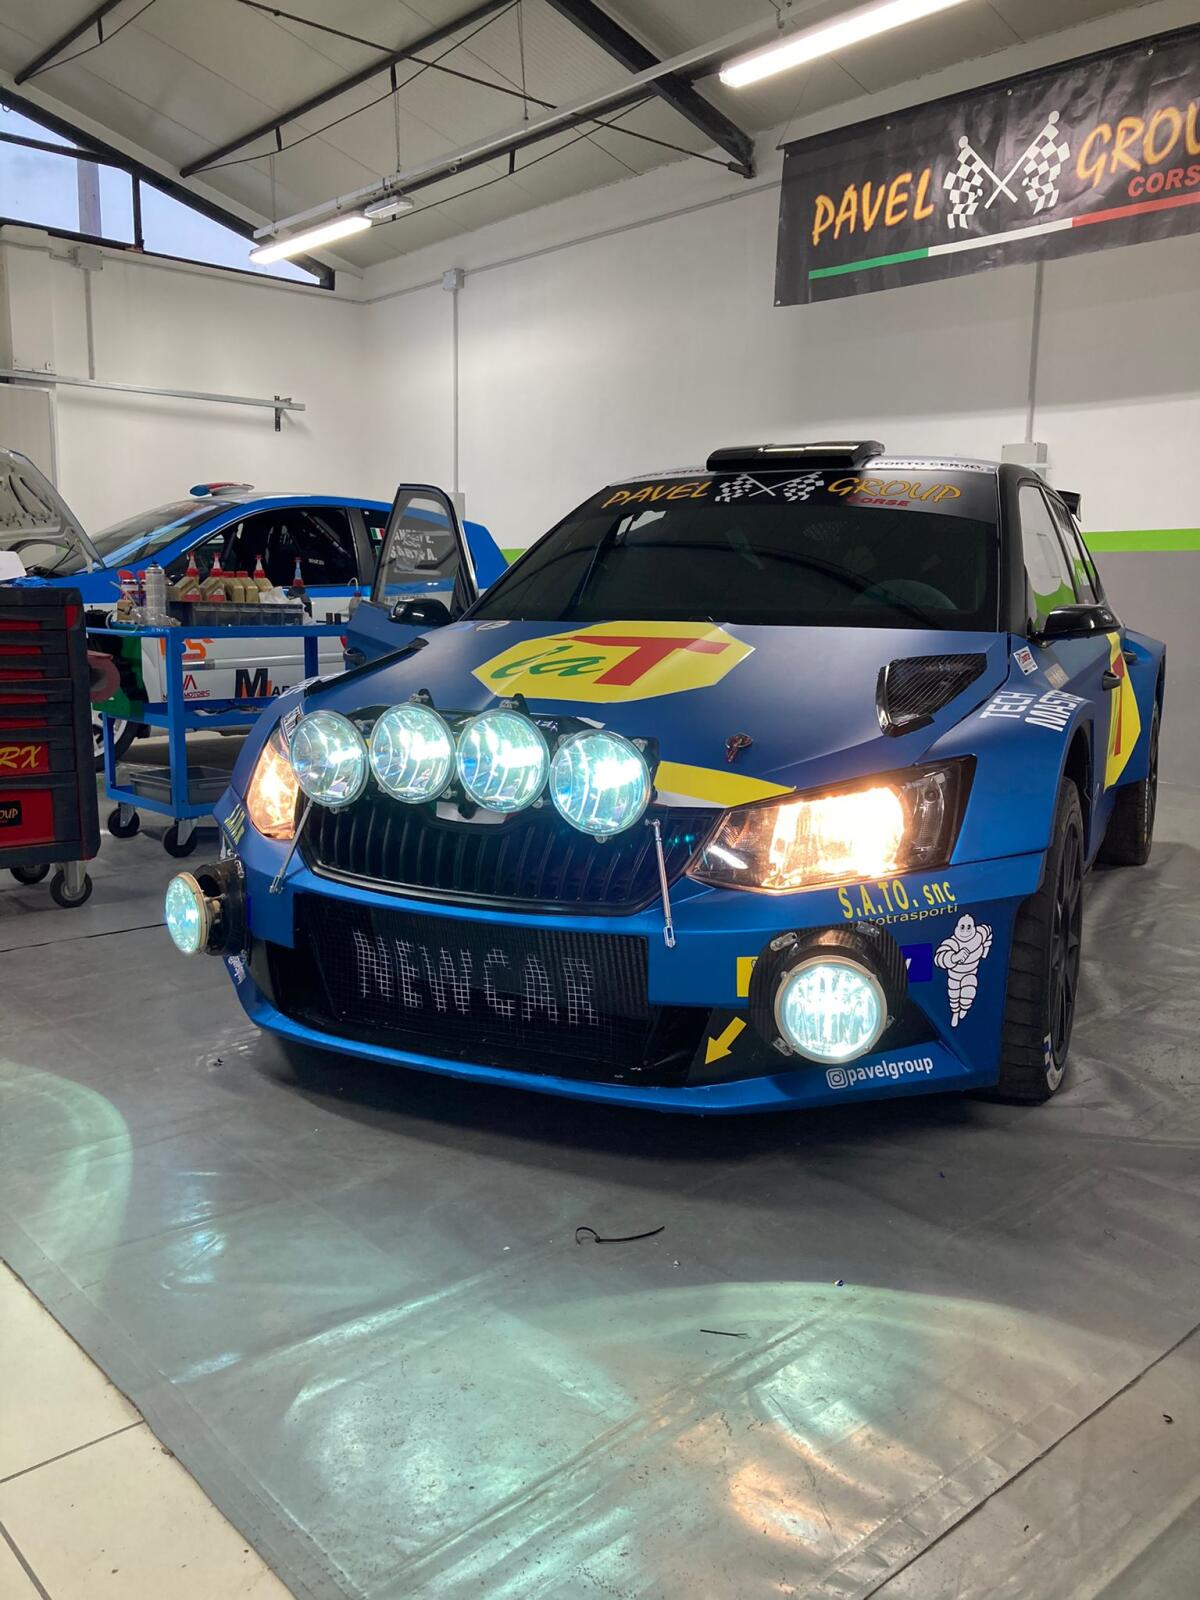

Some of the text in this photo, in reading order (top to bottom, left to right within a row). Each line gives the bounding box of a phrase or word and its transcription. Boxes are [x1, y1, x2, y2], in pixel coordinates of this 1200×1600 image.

[1128, 164, 1200, 197] CORS
[812, 168, 934, 247] PAVEL
[601, 477, 961, 509] PAVEL GROUP
[847, 496, 911, 507] CORSE
[980, 691, 1037, 719] TECH
[922, 881, 956, 906] snc
[353, 929, 599, 1026] NEWCAR
[847, 1057, 933, 1086] pavelgroup
